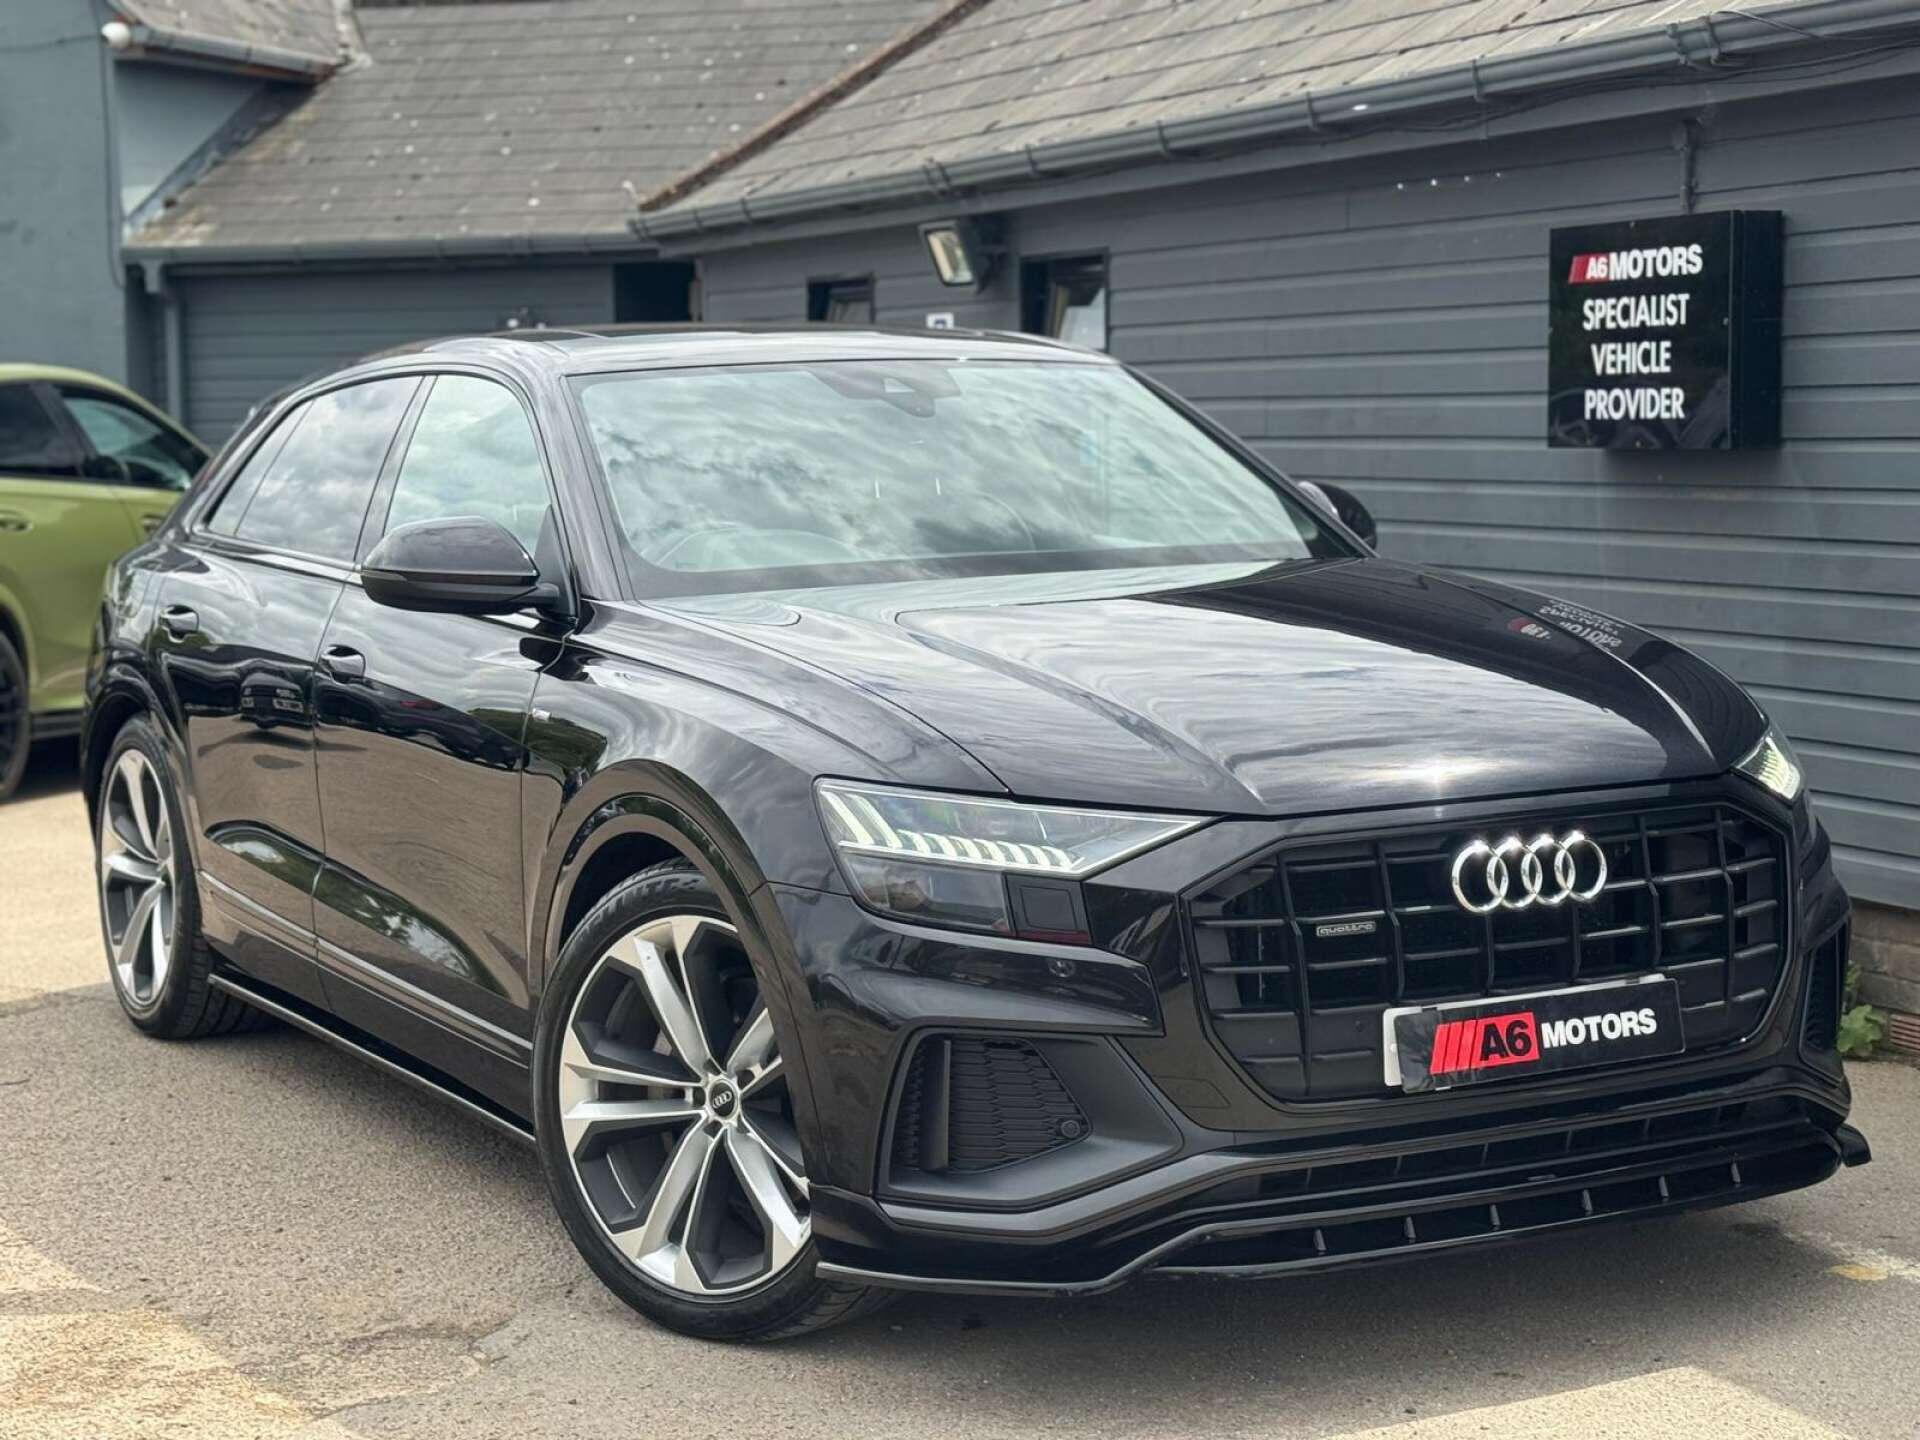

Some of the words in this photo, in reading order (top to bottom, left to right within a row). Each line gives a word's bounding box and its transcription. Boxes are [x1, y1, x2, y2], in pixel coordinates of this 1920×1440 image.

[1608, 243, 1704, 281] MOTORS
[1582, 293, 1691, 331] SPECIALIST
[1590, 340, 1672, 376] VEHICLE
[1583, 387, 1686, 421] PROVIDER
[1320, 922, 1373, 937] quattro
[1479, 1018, 1533, 1063] A6
[1541, 1007, 1658, 1050] MOTORS
